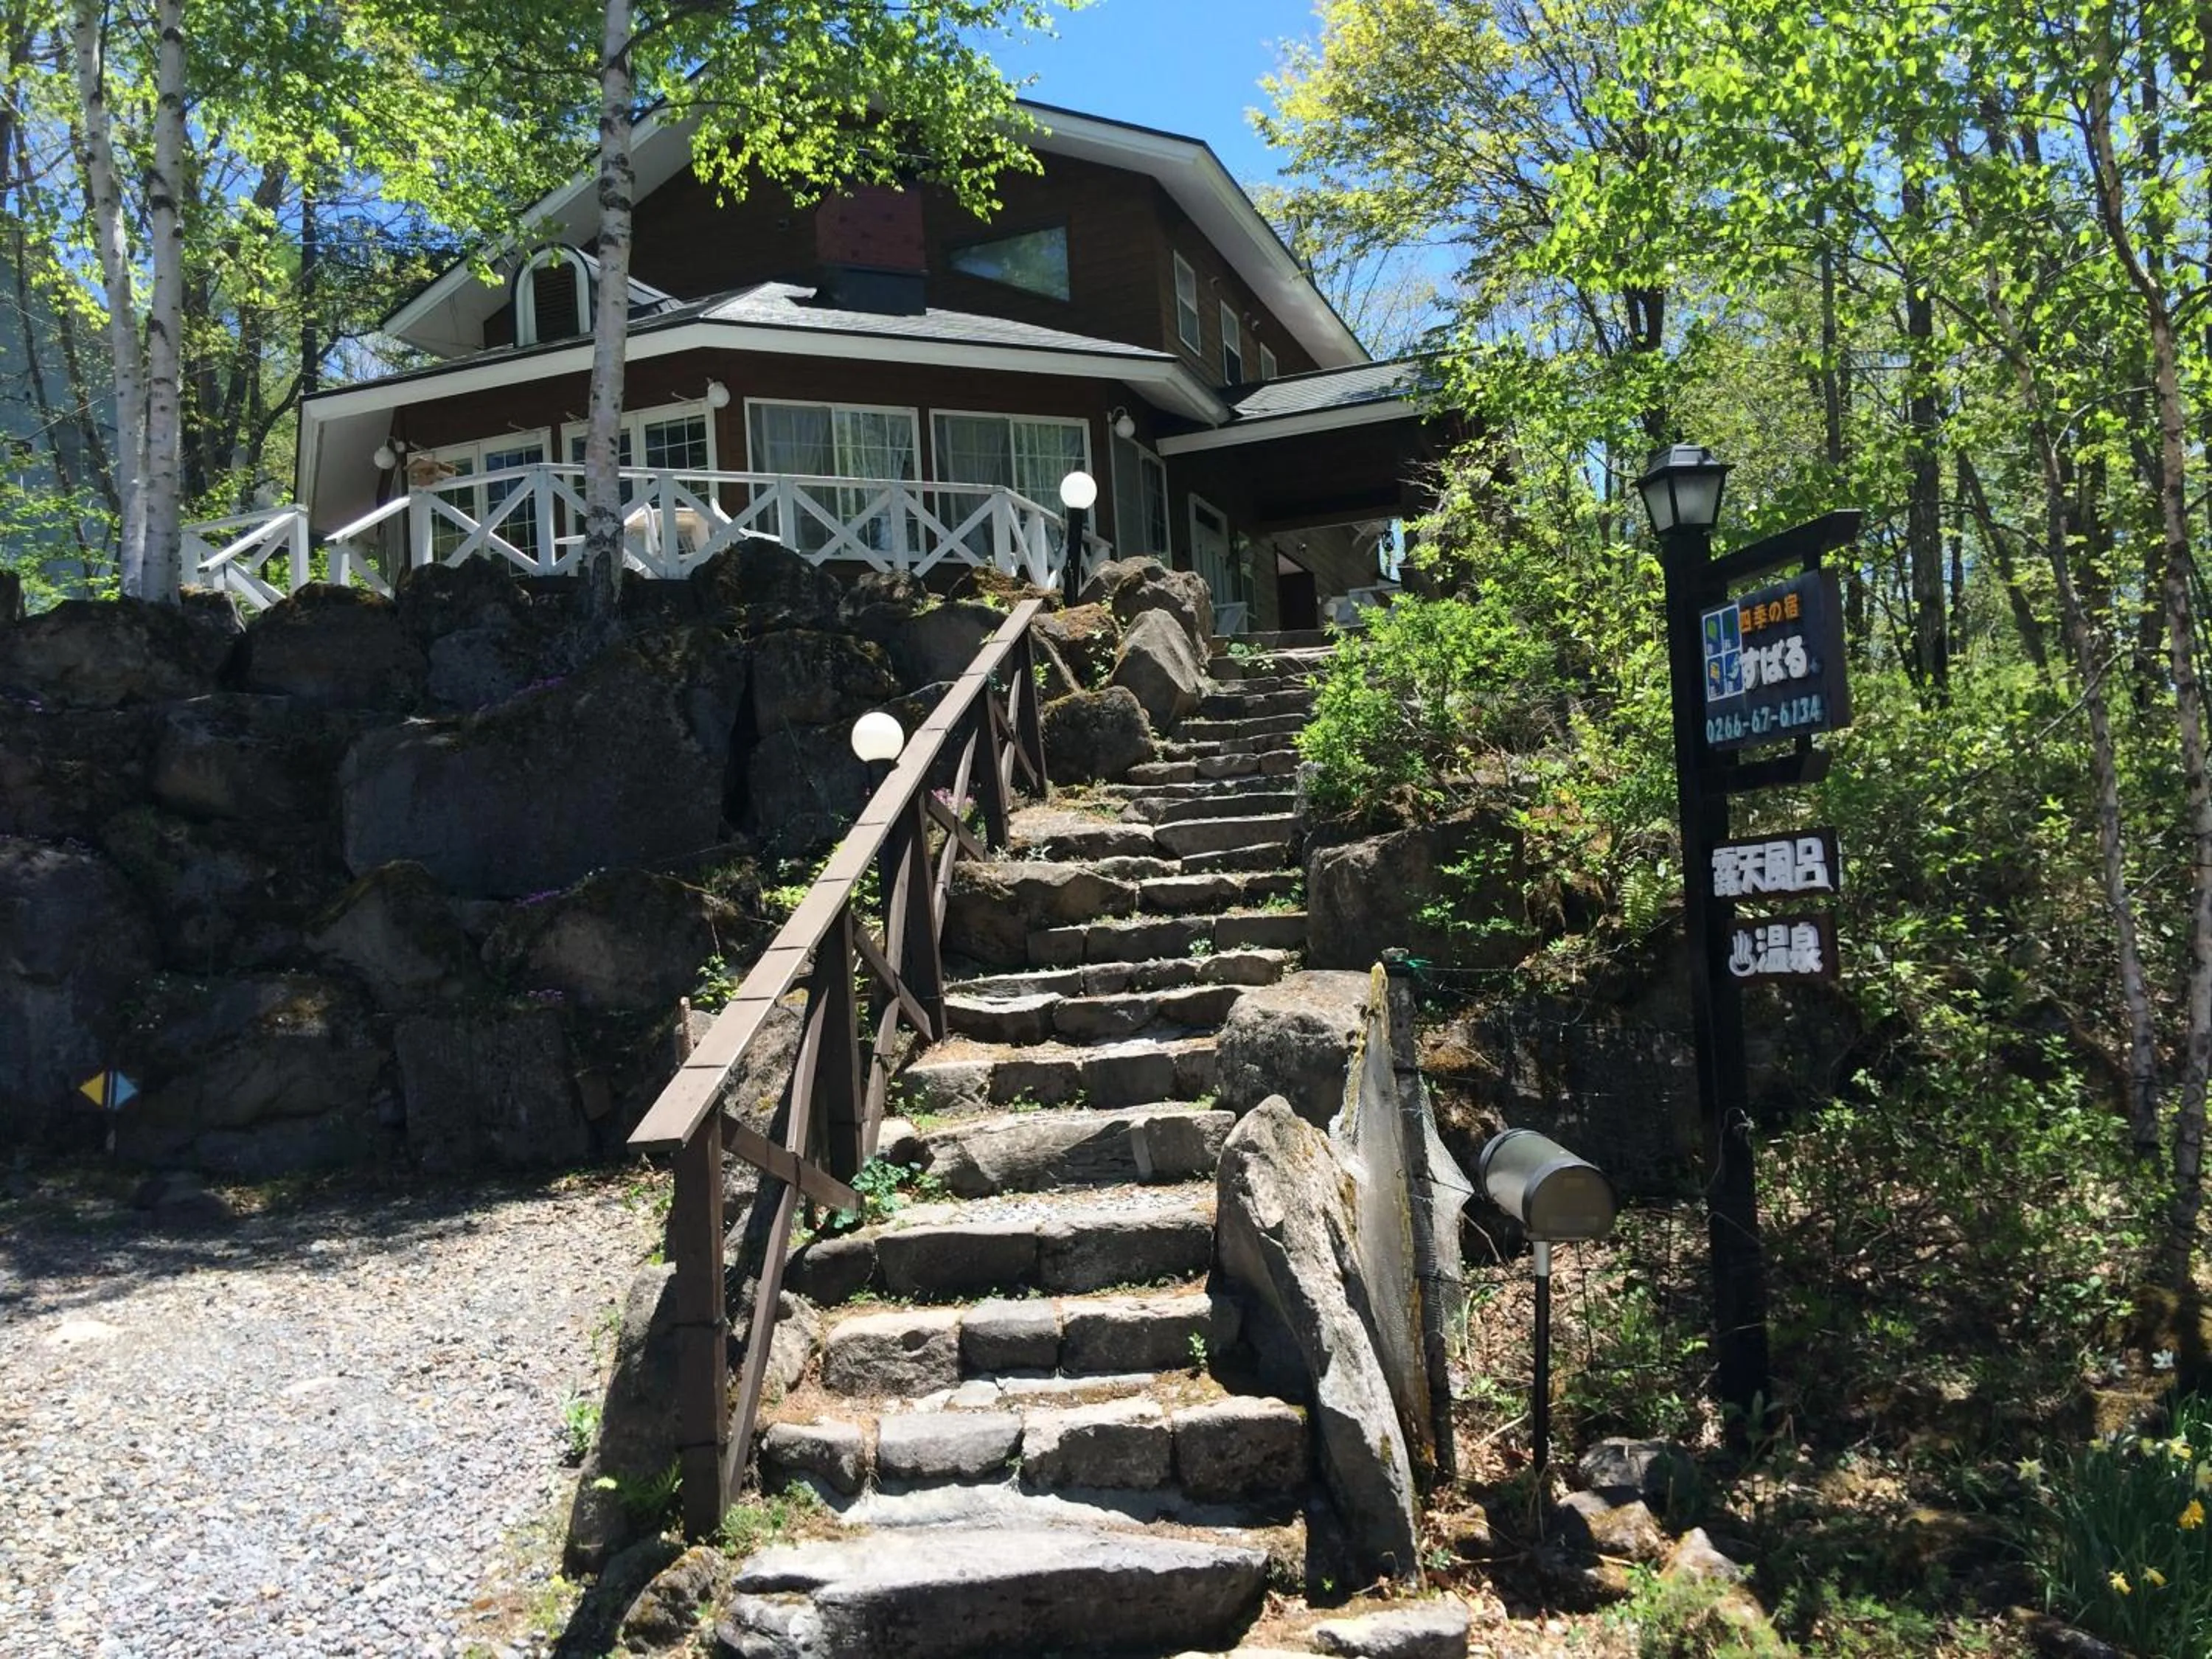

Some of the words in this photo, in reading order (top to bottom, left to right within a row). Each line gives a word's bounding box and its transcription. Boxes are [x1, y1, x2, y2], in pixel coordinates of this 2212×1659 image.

[1739, 635, 1808, 689] すばる
[1705, 695, 1822, 744] 0266-67-6134
